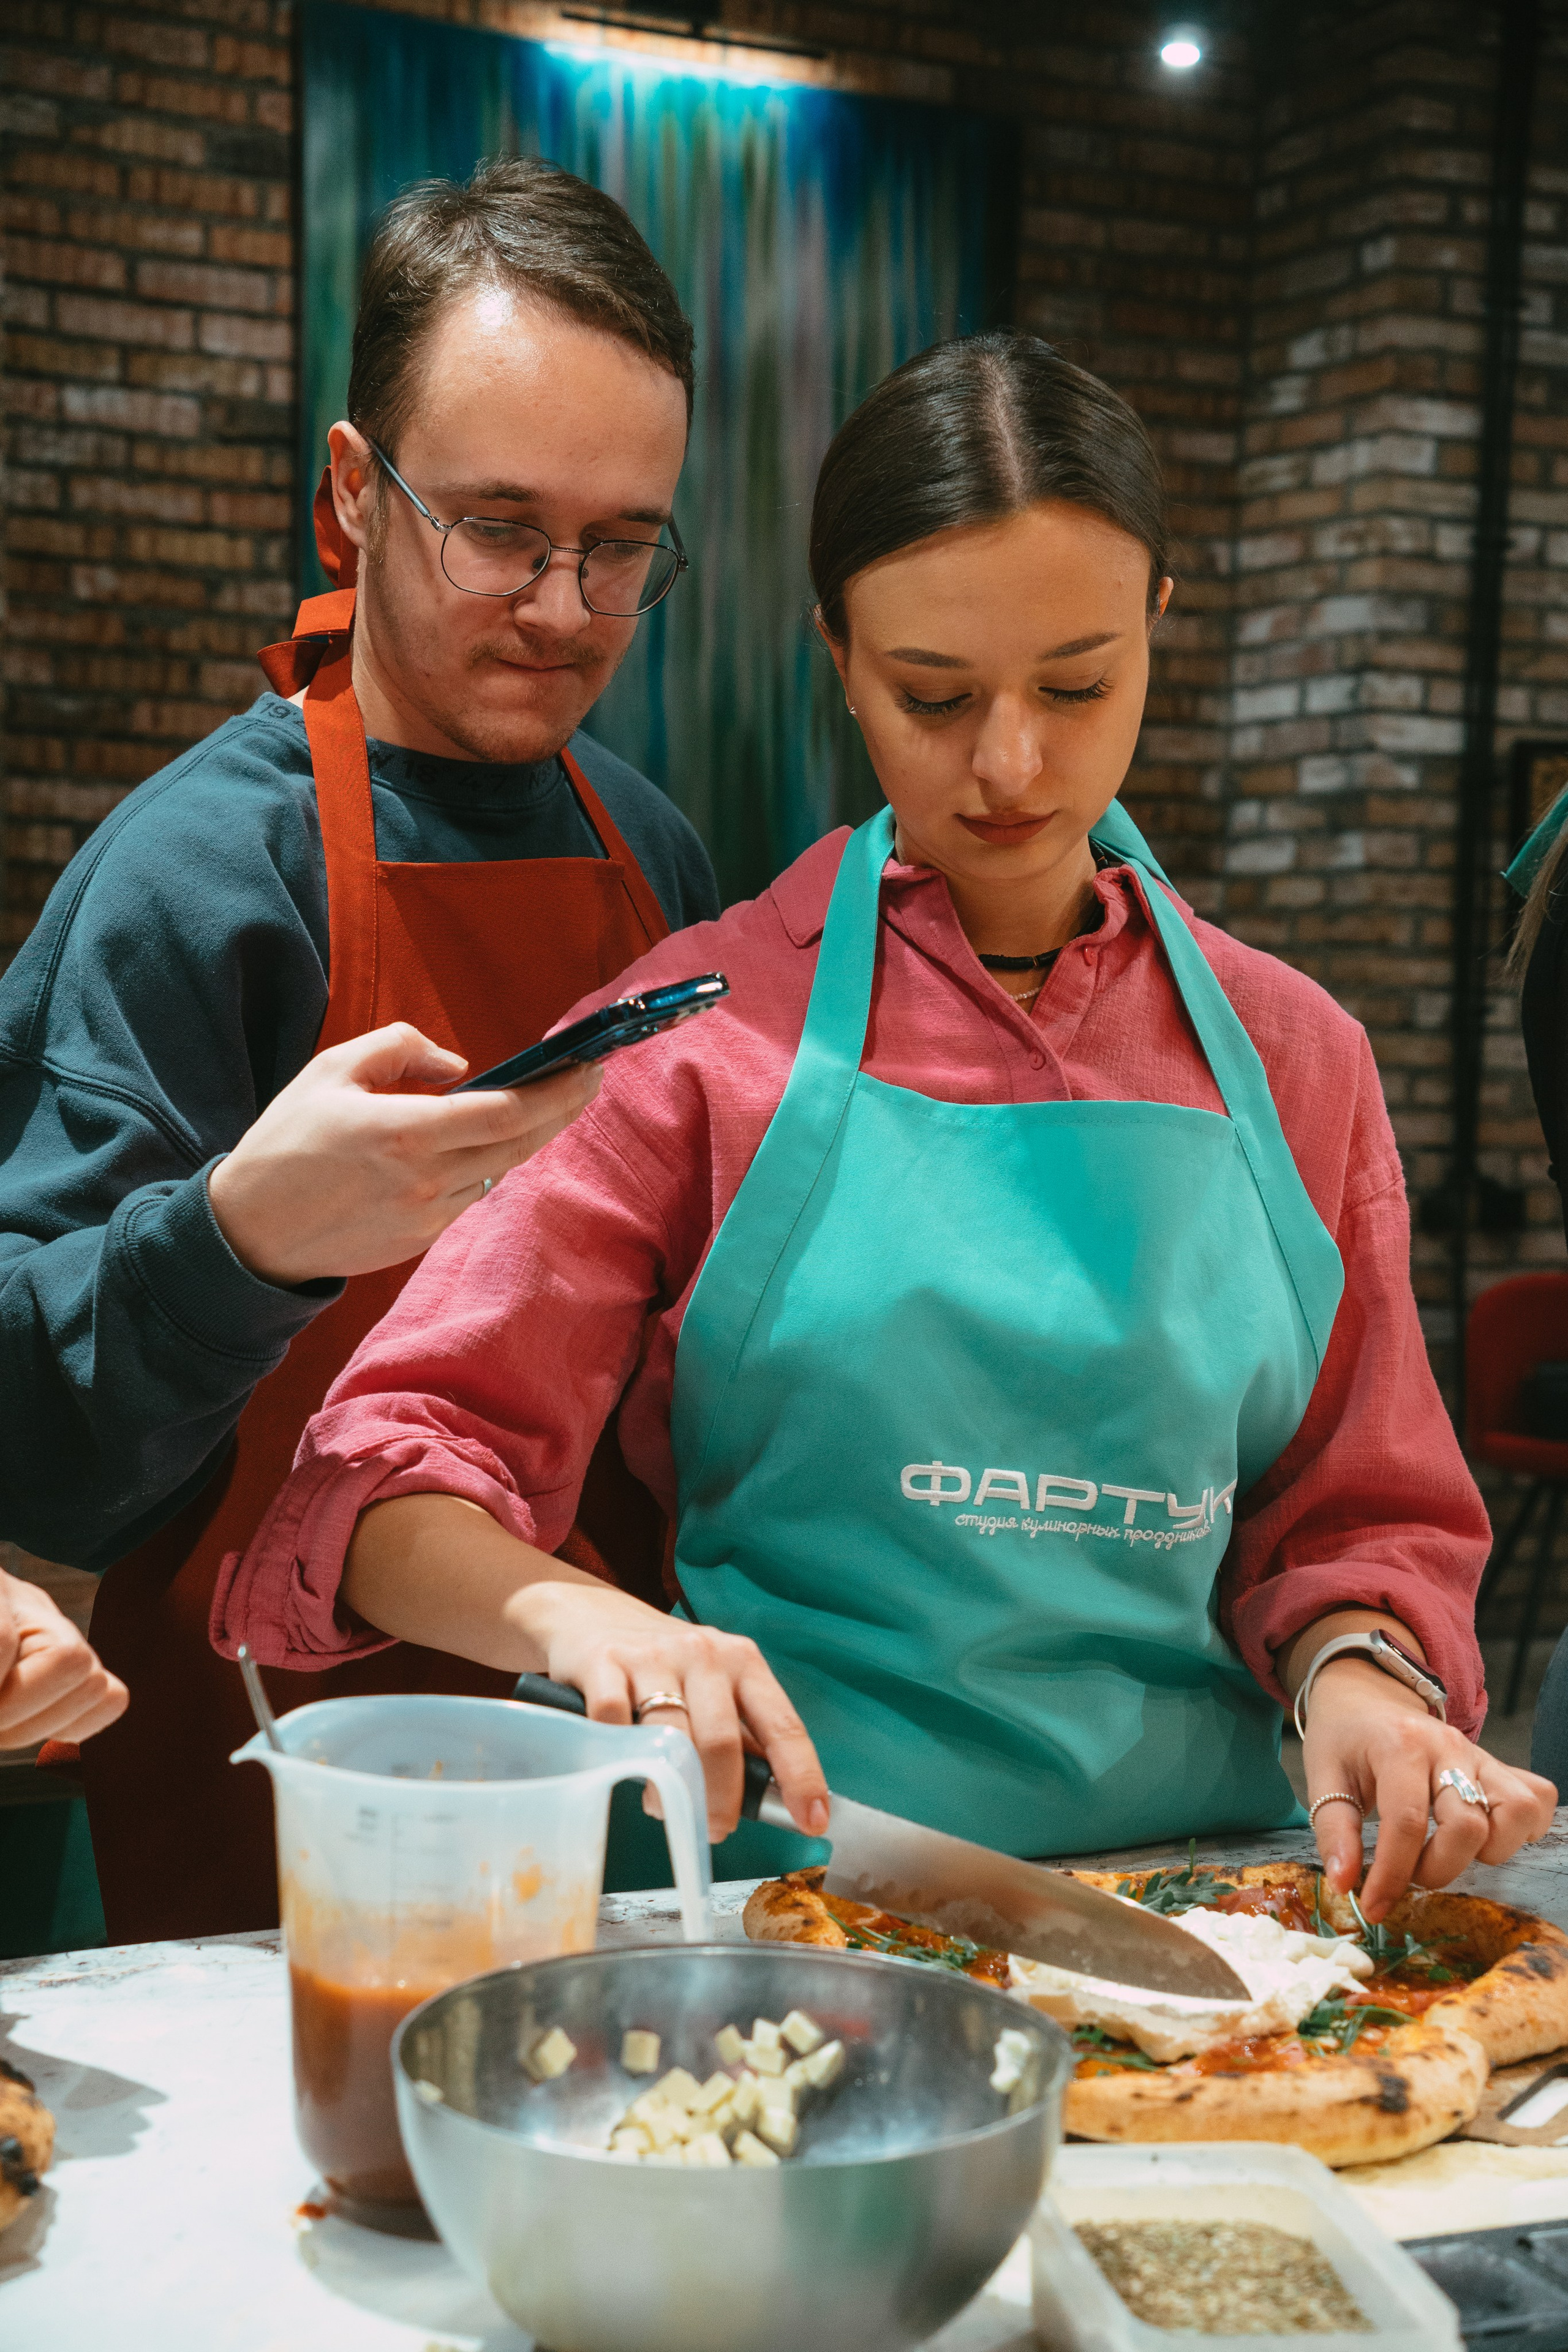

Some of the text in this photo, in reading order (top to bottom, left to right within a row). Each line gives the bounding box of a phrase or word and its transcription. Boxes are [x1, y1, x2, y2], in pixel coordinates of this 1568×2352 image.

[900, 1460, 1238, 1529] ФАРТУК
[954, 1512, 1018, 1537] студия
[1021, 1517, 1121, 1542] кулинарных
